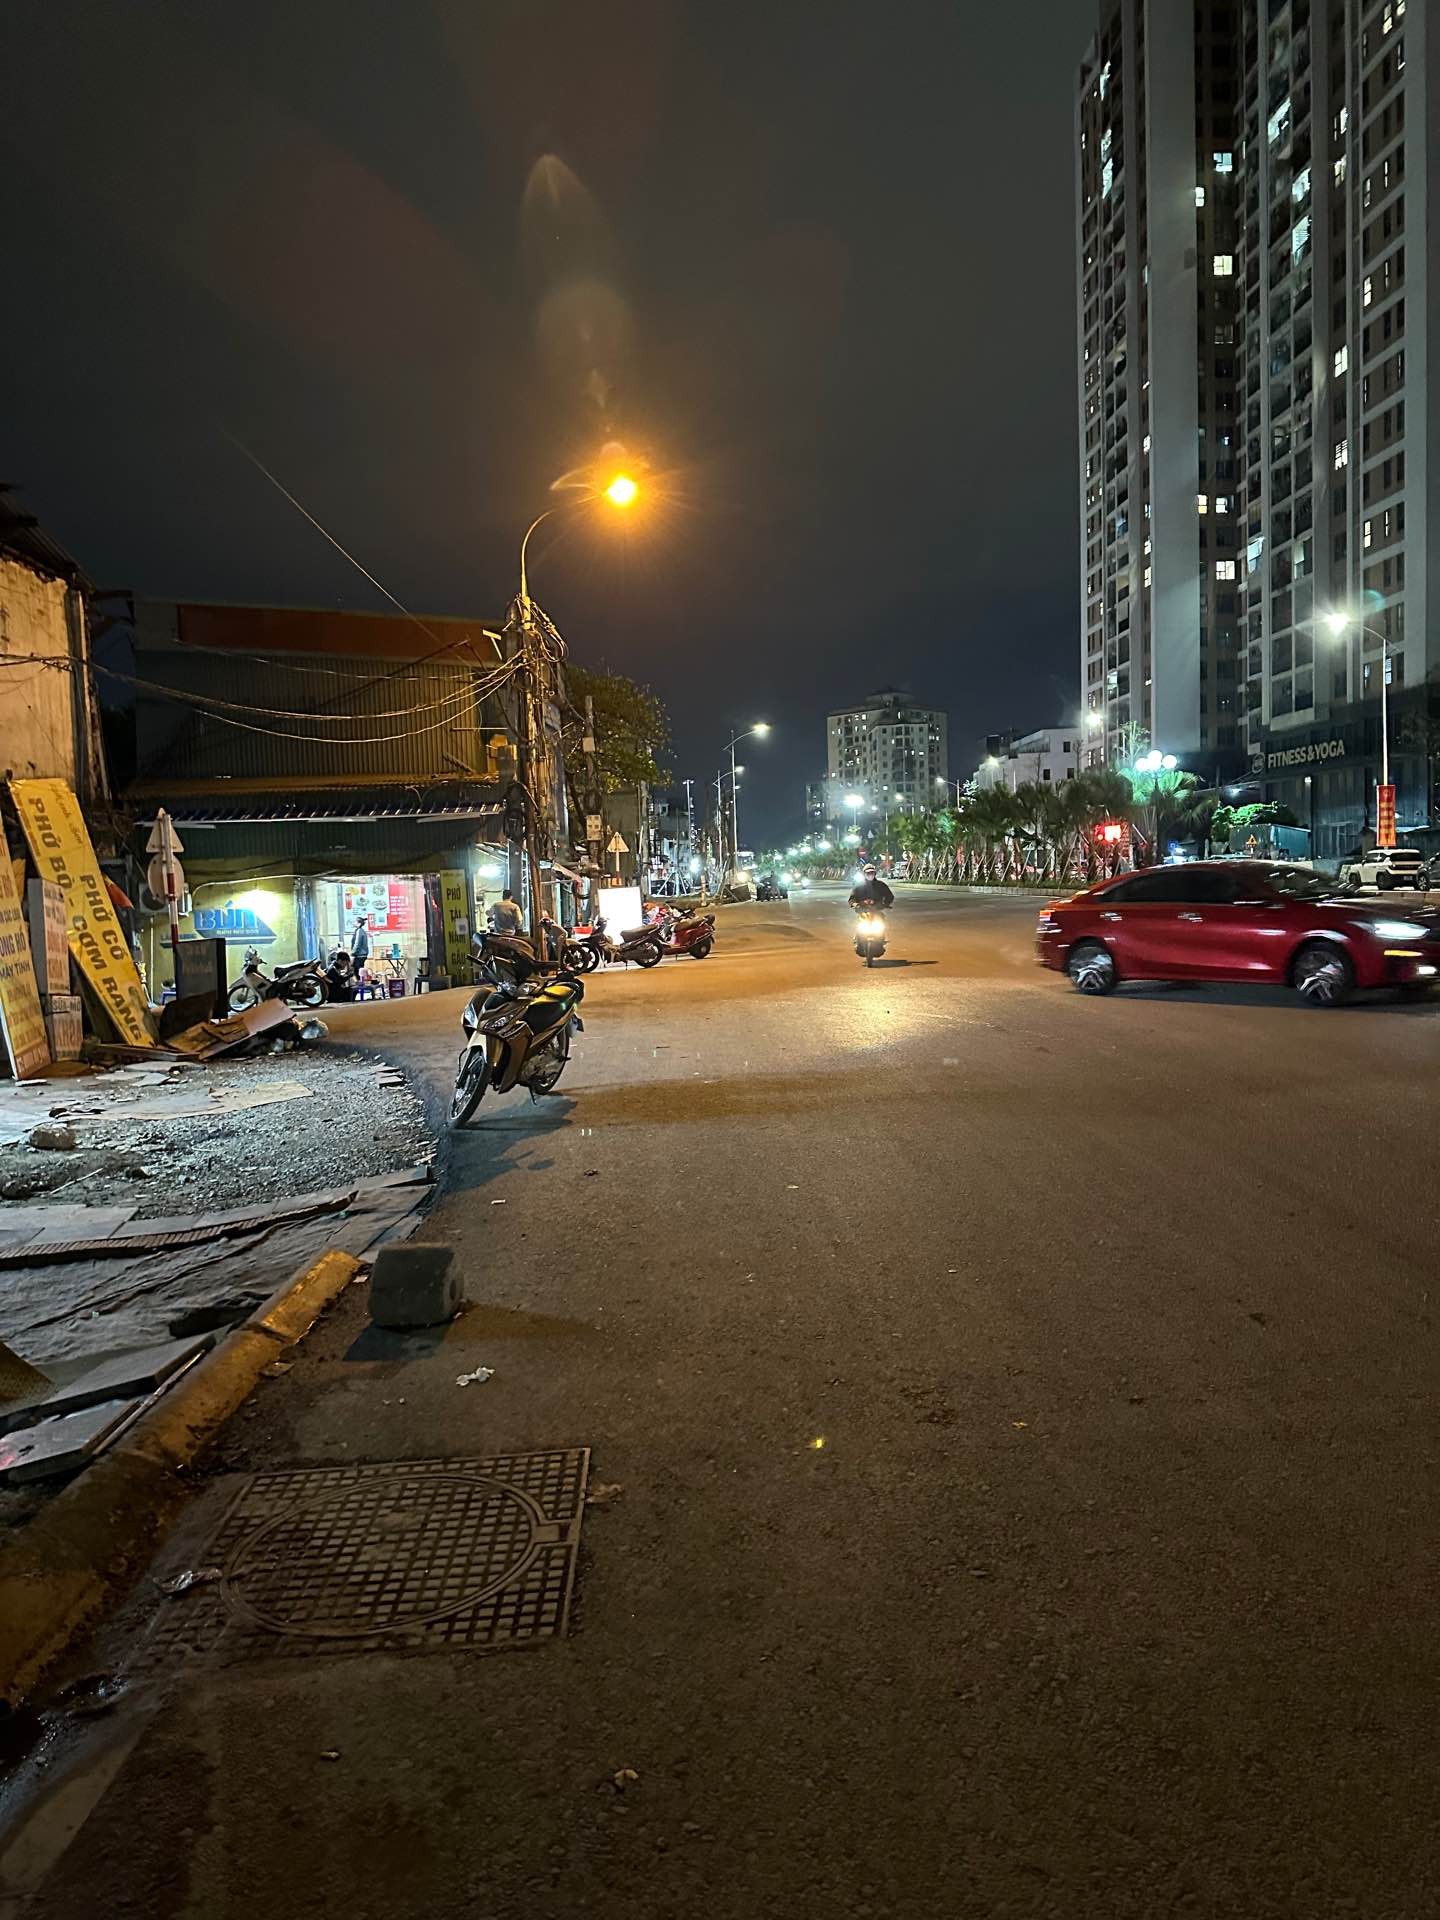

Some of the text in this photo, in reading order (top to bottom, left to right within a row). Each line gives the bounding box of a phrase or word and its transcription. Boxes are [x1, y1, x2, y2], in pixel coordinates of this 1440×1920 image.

[28, 797, 62, 850] PHỞ
[72, 915, 108, 970] CƠM
[101, 976, 143, 1041] RANG
[80, 874, 114, 922] PHỞ
